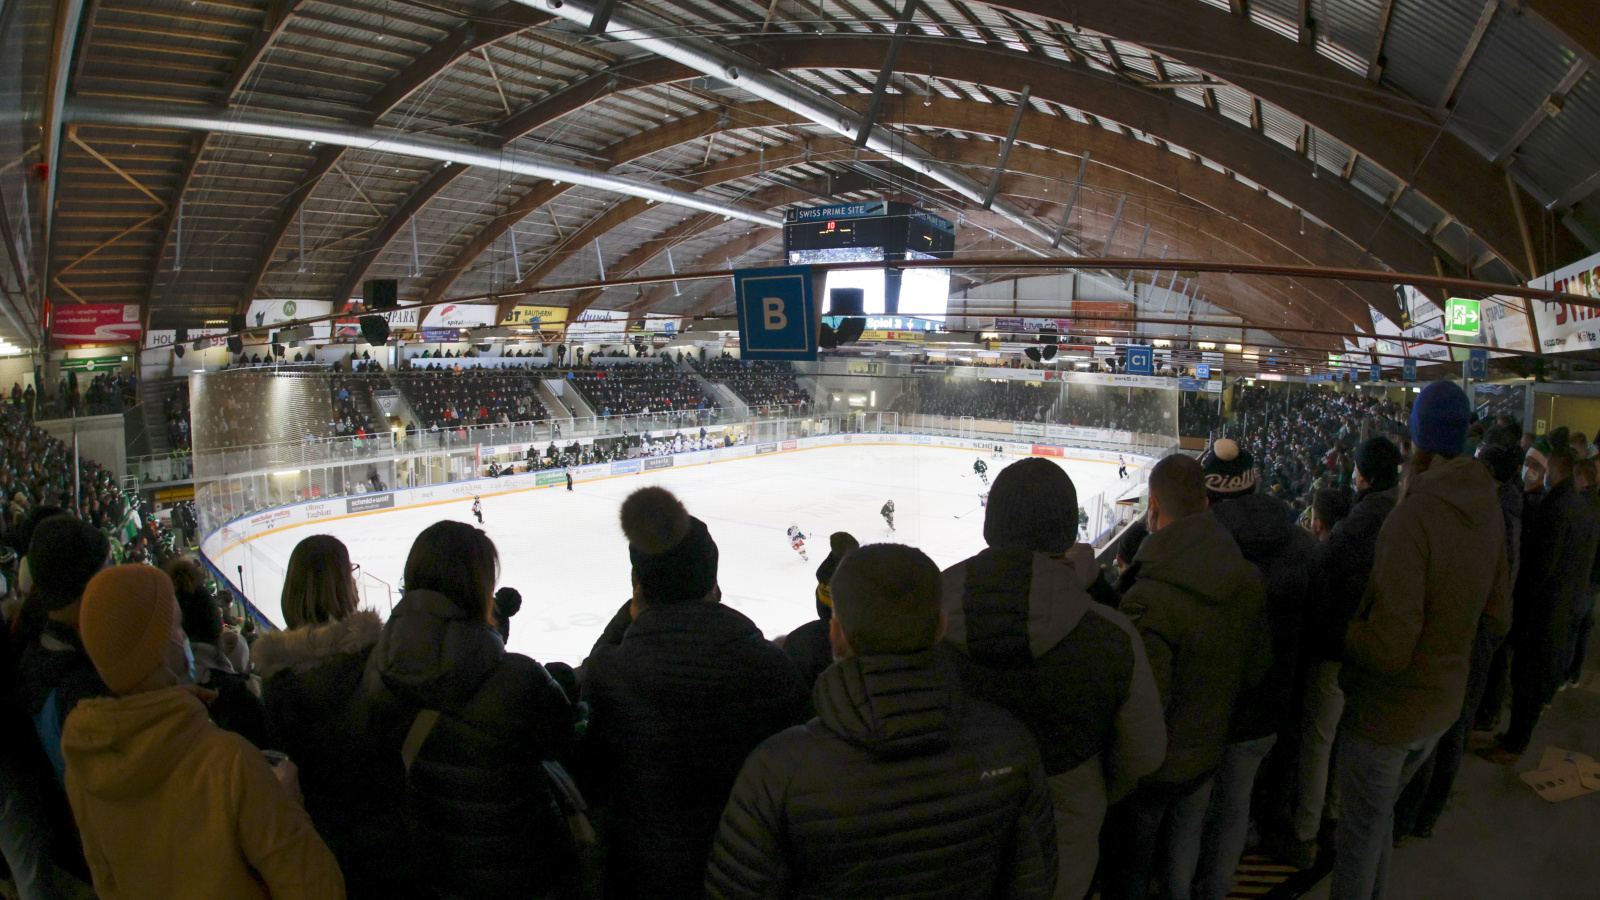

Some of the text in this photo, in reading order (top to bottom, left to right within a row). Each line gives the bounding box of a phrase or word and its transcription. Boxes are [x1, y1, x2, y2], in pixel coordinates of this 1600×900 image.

[799, 205, 865, 219] SWISS PRIME SITE
[827, 221, 836, 230] 10
[926, 214, 939, 227] PRIME
[938, 219, 947, 229] SITE
[762, 297, 788, 330] B
[1131, 355, 1147, 366] C1
[1472, 357, 1485, 371] C1
[1404, 363, 1415, 374] C1
[351, 495, 390, 506] schmid+wolf
[306, 510, 332, 519] Tagblatt
